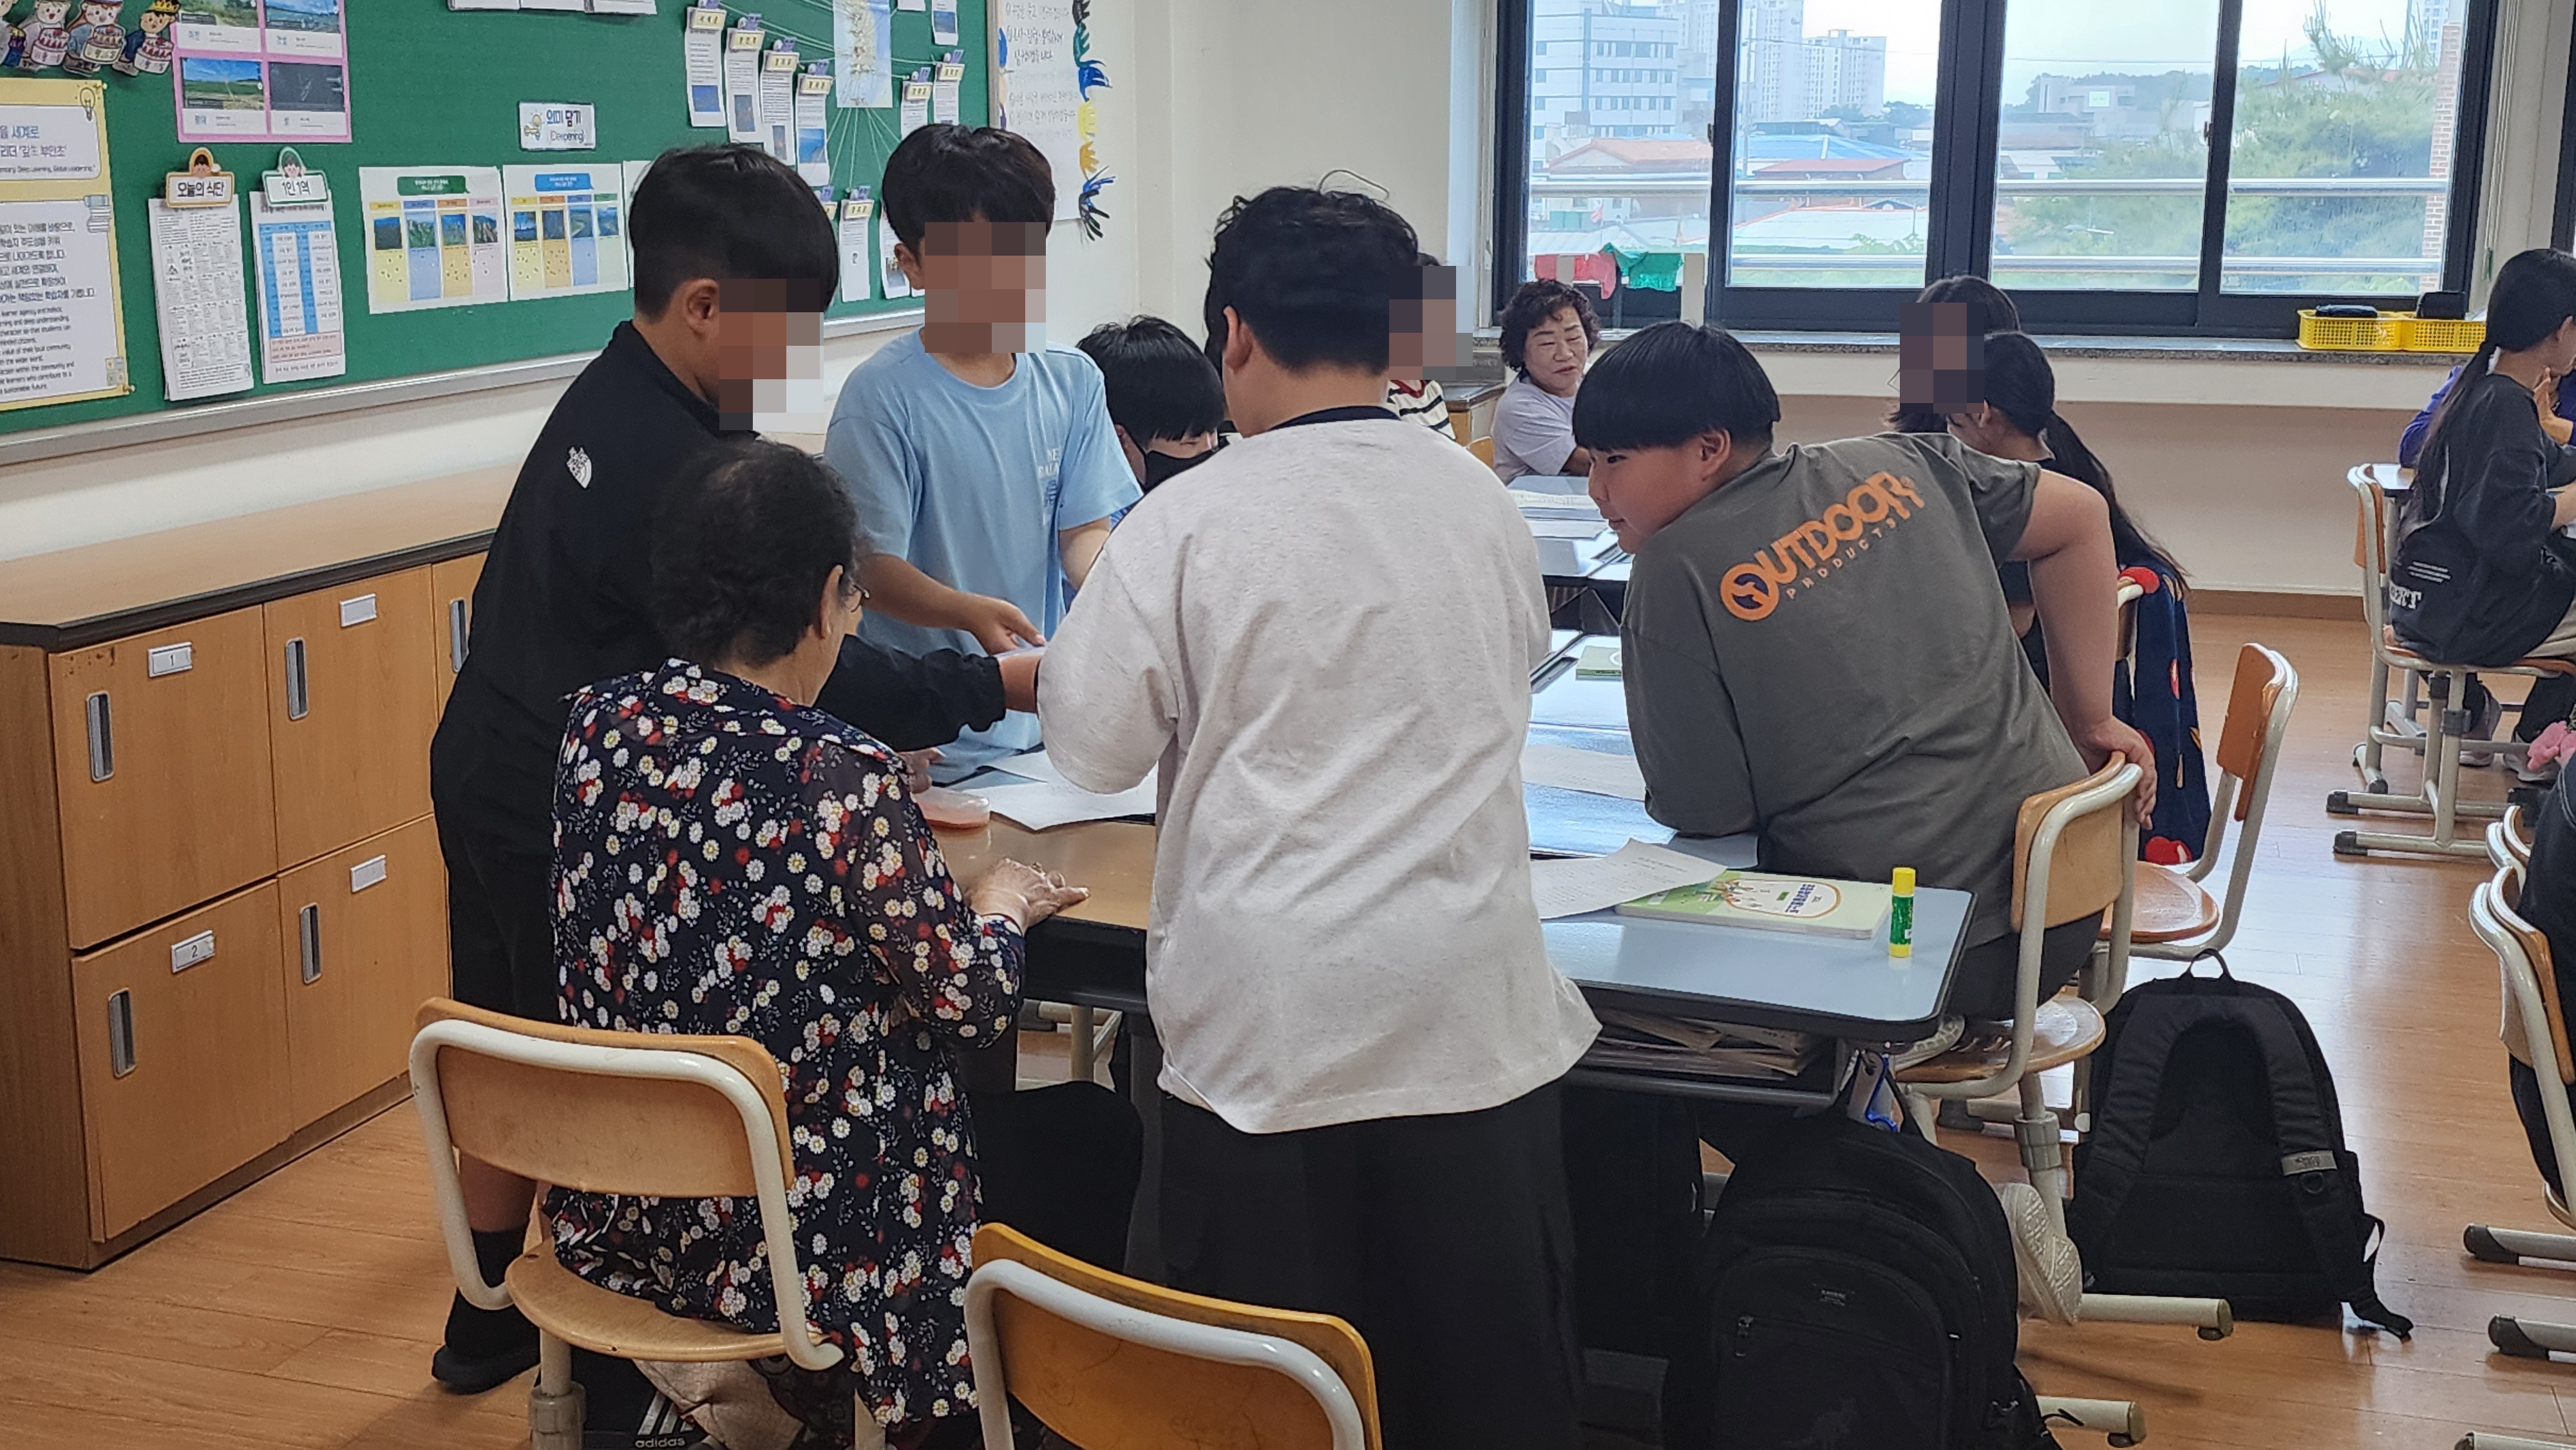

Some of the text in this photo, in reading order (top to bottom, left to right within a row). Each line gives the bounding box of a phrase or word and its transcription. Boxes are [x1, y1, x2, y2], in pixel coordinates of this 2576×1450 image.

[546, 109, 582, 127] 의미 담기
[12, 125, 40, 138] 세계로
[178, 181, 224, 197] 오늘의 식단
[282, 180, 310, 196] 1인 1역
[1720, 472, 1925, 621] OUTDOOR
[1786, 517, 1897, 599] PRODUCTS
[170, 654, 174, 666] 1
[191, 945, 198, 958] 2
[635, 1438, 685, 1448] adidas
